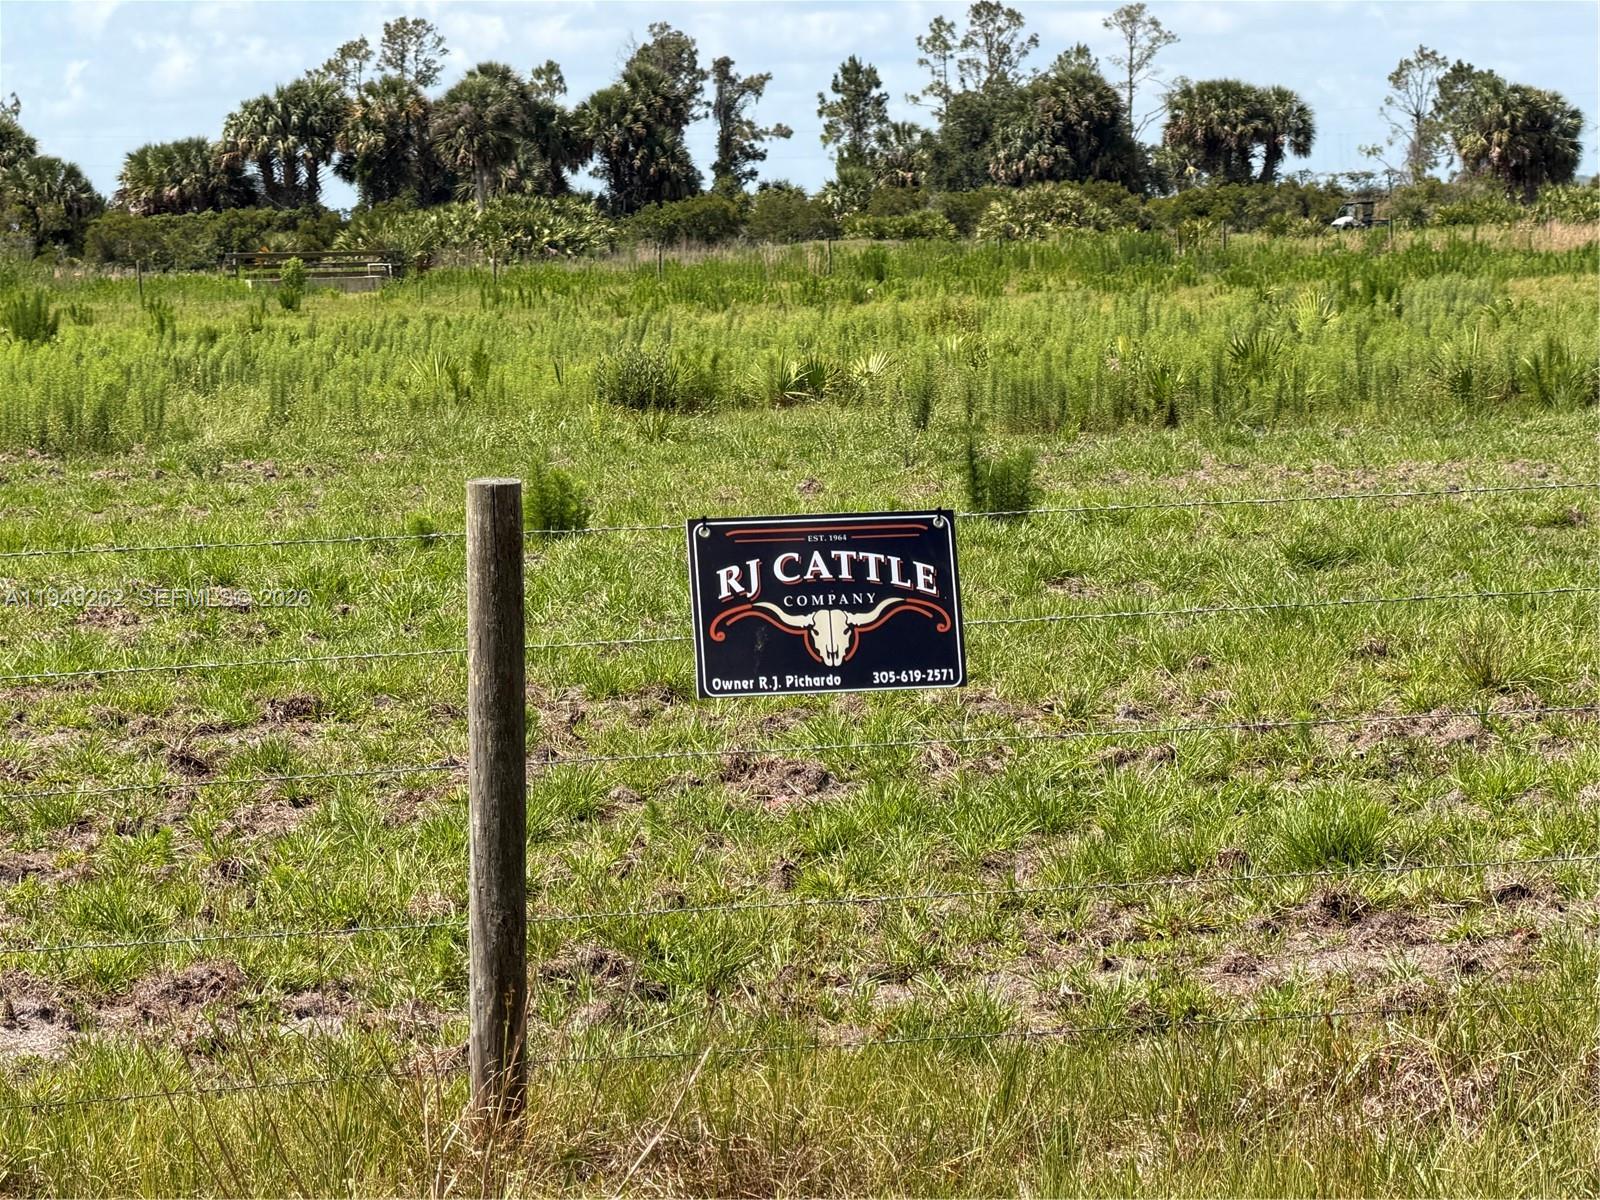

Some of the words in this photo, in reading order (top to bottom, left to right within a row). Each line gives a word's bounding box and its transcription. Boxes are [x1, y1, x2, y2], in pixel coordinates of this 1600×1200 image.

[807, 535, 827, 543] EST.
[829, 534, 847, 542] 1964
[716, 557, 762, 600] RJ
[773, 550, 940, 597] CATTLE
[783, 592, 876, 607] COMPANY
[712, 677, 754, 691] Owner
[758, 677, 782, 690] R.J.
[786, 674, 842, 688] Pichardo
[872, 668, 955, 684] 305-619-2571
